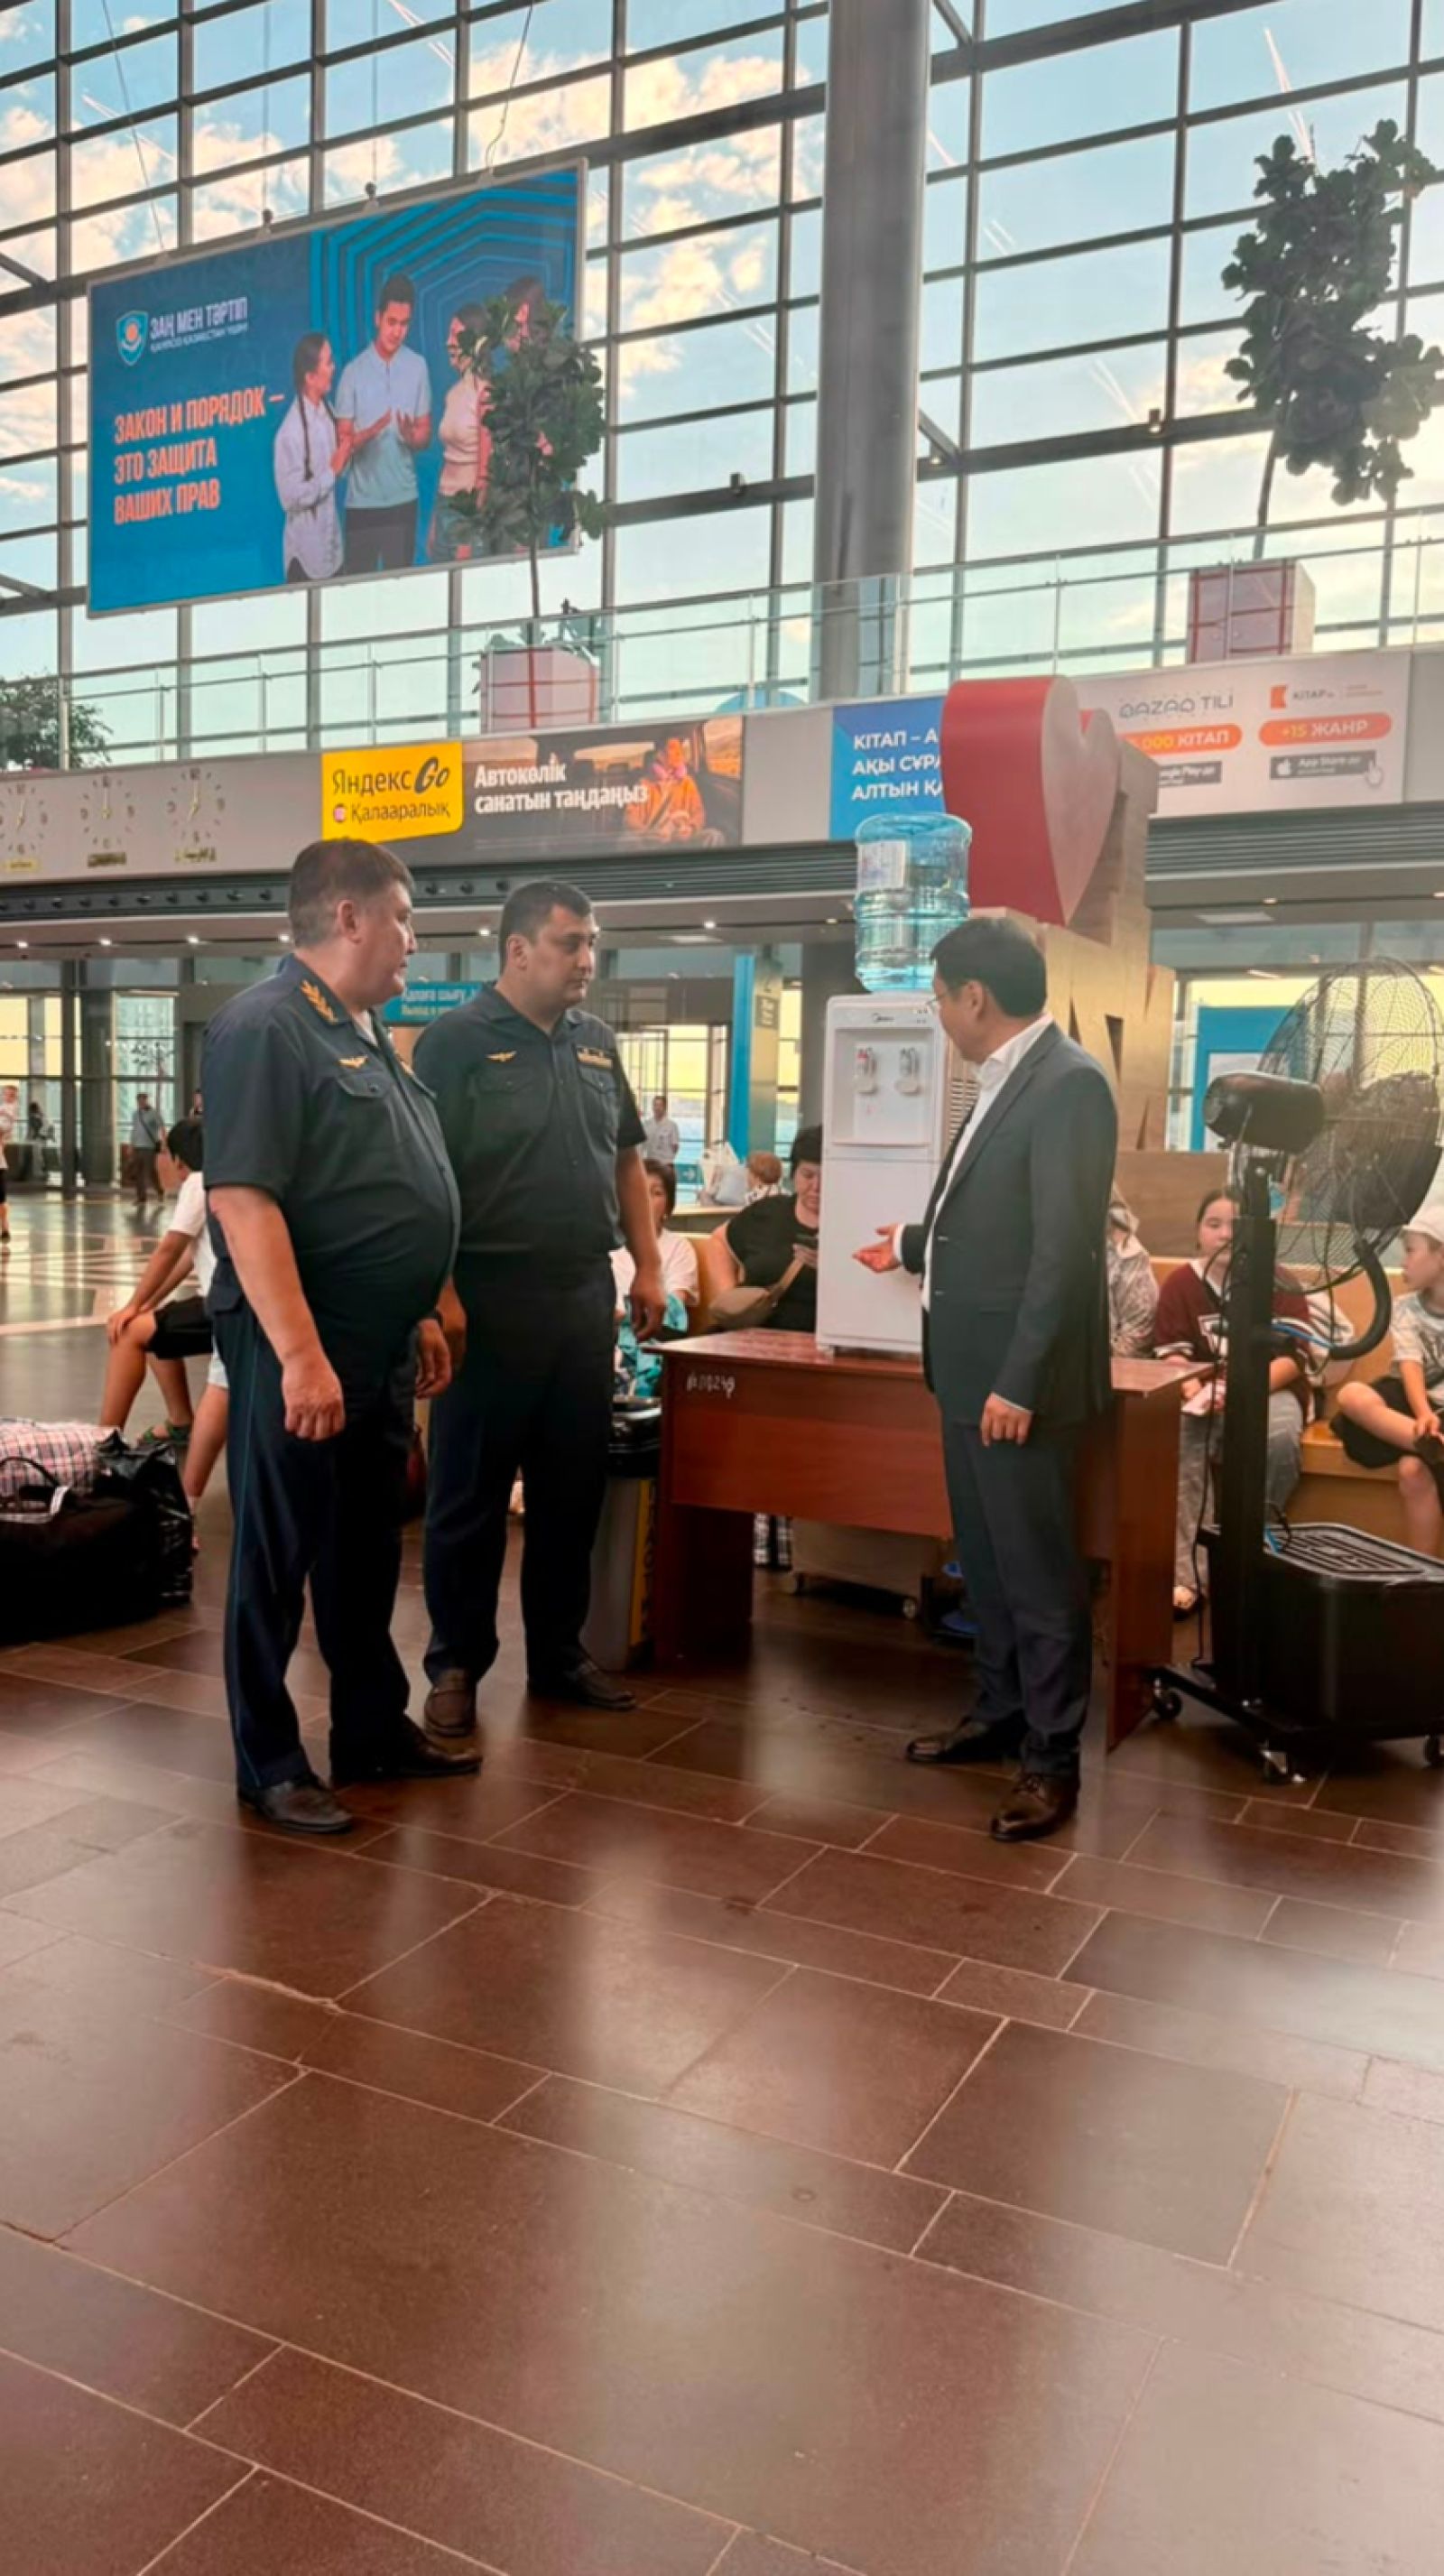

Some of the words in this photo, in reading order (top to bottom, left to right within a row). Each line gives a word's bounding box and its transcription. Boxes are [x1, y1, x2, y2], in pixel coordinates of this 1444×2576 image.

[176, 307, 203, 334] МЕН
[115, 406, 167, 445] ЗАКОН
[171, 403, 182, 433] И
[186, 385, 266, 426] ПОРЯДОК
[115, 451, 143, 485] ЭТО
[148, 437, 217, 477] ЗАЩИТА
[115, 487, 172, 525] ВАШИХ
[176, 477, 220, 514] ПРАВ
[1200, 694, 1233, 710] TILI
[854, 729, 906, 751] КІТАП
[1177, 729, 1229, 748] КІТАП
[1310, 719, 1368, 738] ЖАНР
[333, 769, 412, 797] Яндекс
[414, 755, 450, 794] Go
[475, 763, 567, 789] Автокөлік
[852, 757, 895, 776] АҚЫ
[475, 791, 551, 815] санатын
[554, 783, 650, 811] таңдаңыз
[851, 779, 919, 802] АЛТЫН
[351, 802, 450, 824] Қалааралық
